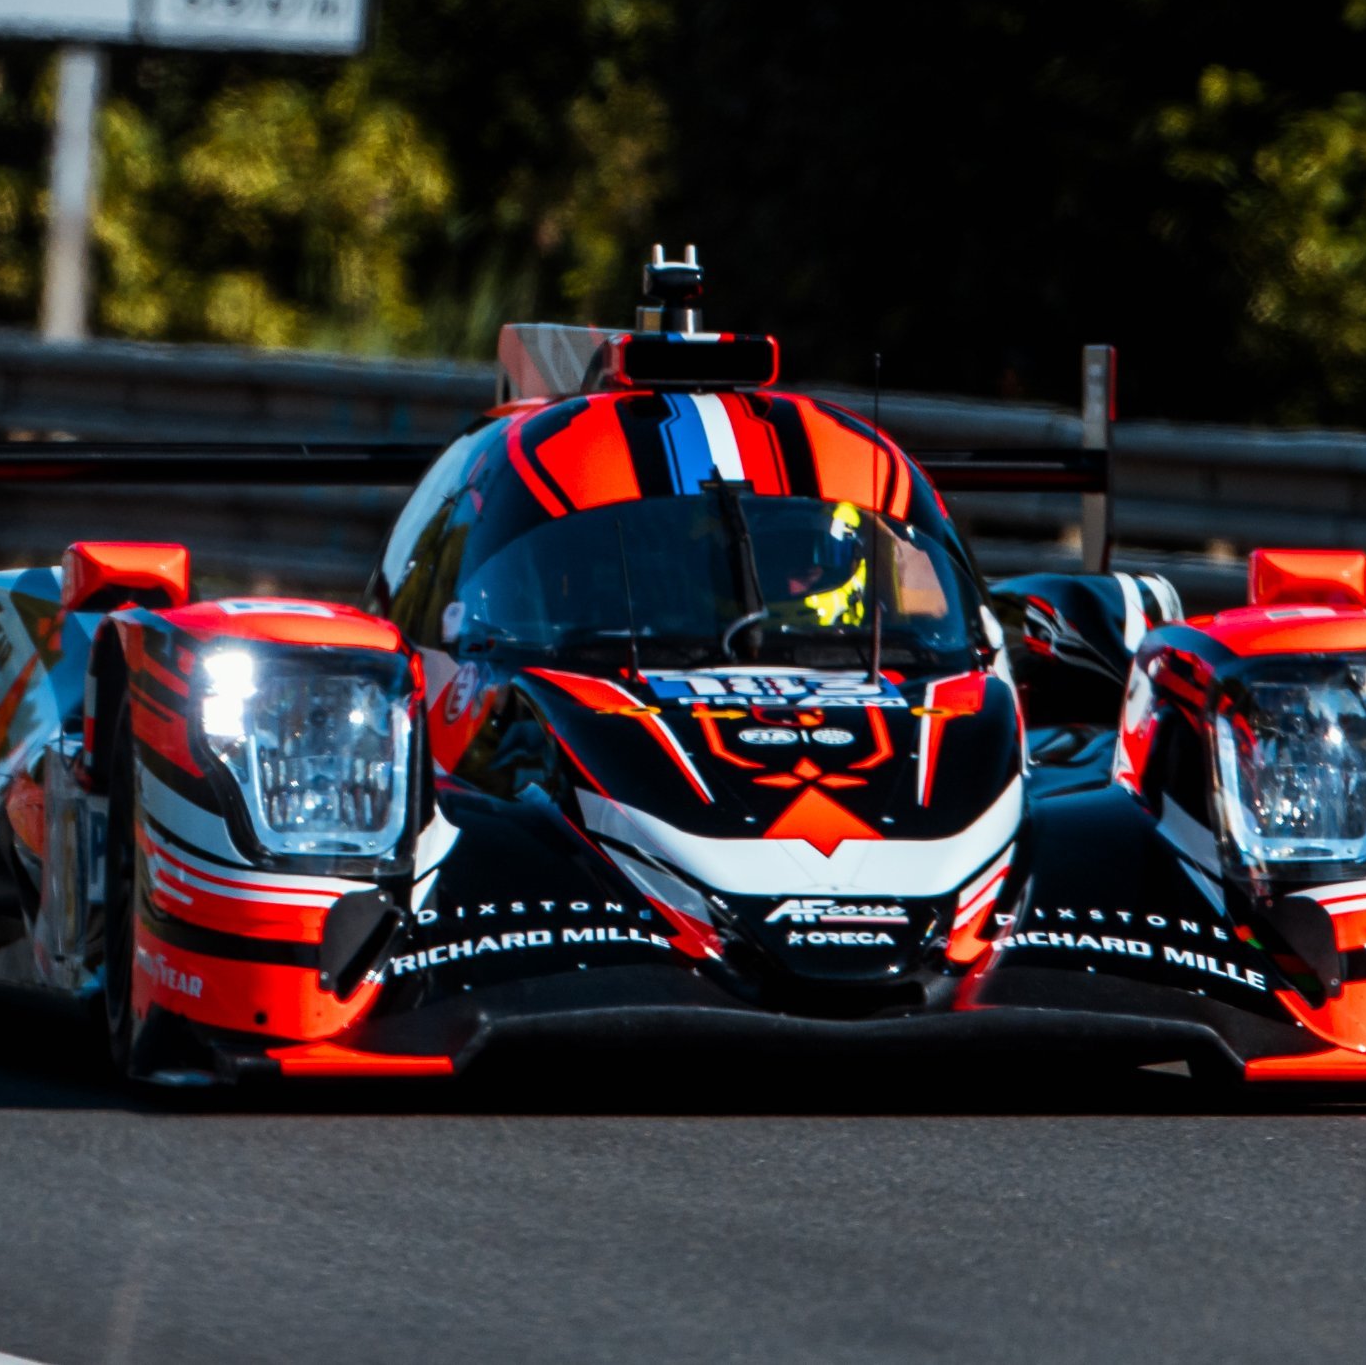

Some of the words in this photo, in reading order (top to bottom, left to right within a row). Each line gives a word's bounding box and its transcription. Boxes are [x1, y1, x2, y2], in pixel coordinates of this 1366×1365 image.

[392, 929, 552, 976] RICHARD
[561, 928, 671, 949] MILLE
[806, 931, 895, 945] ORECA
[991, 931, 1153, 958] RICHARD
[1163, 945, 1266, 991] MILLE
